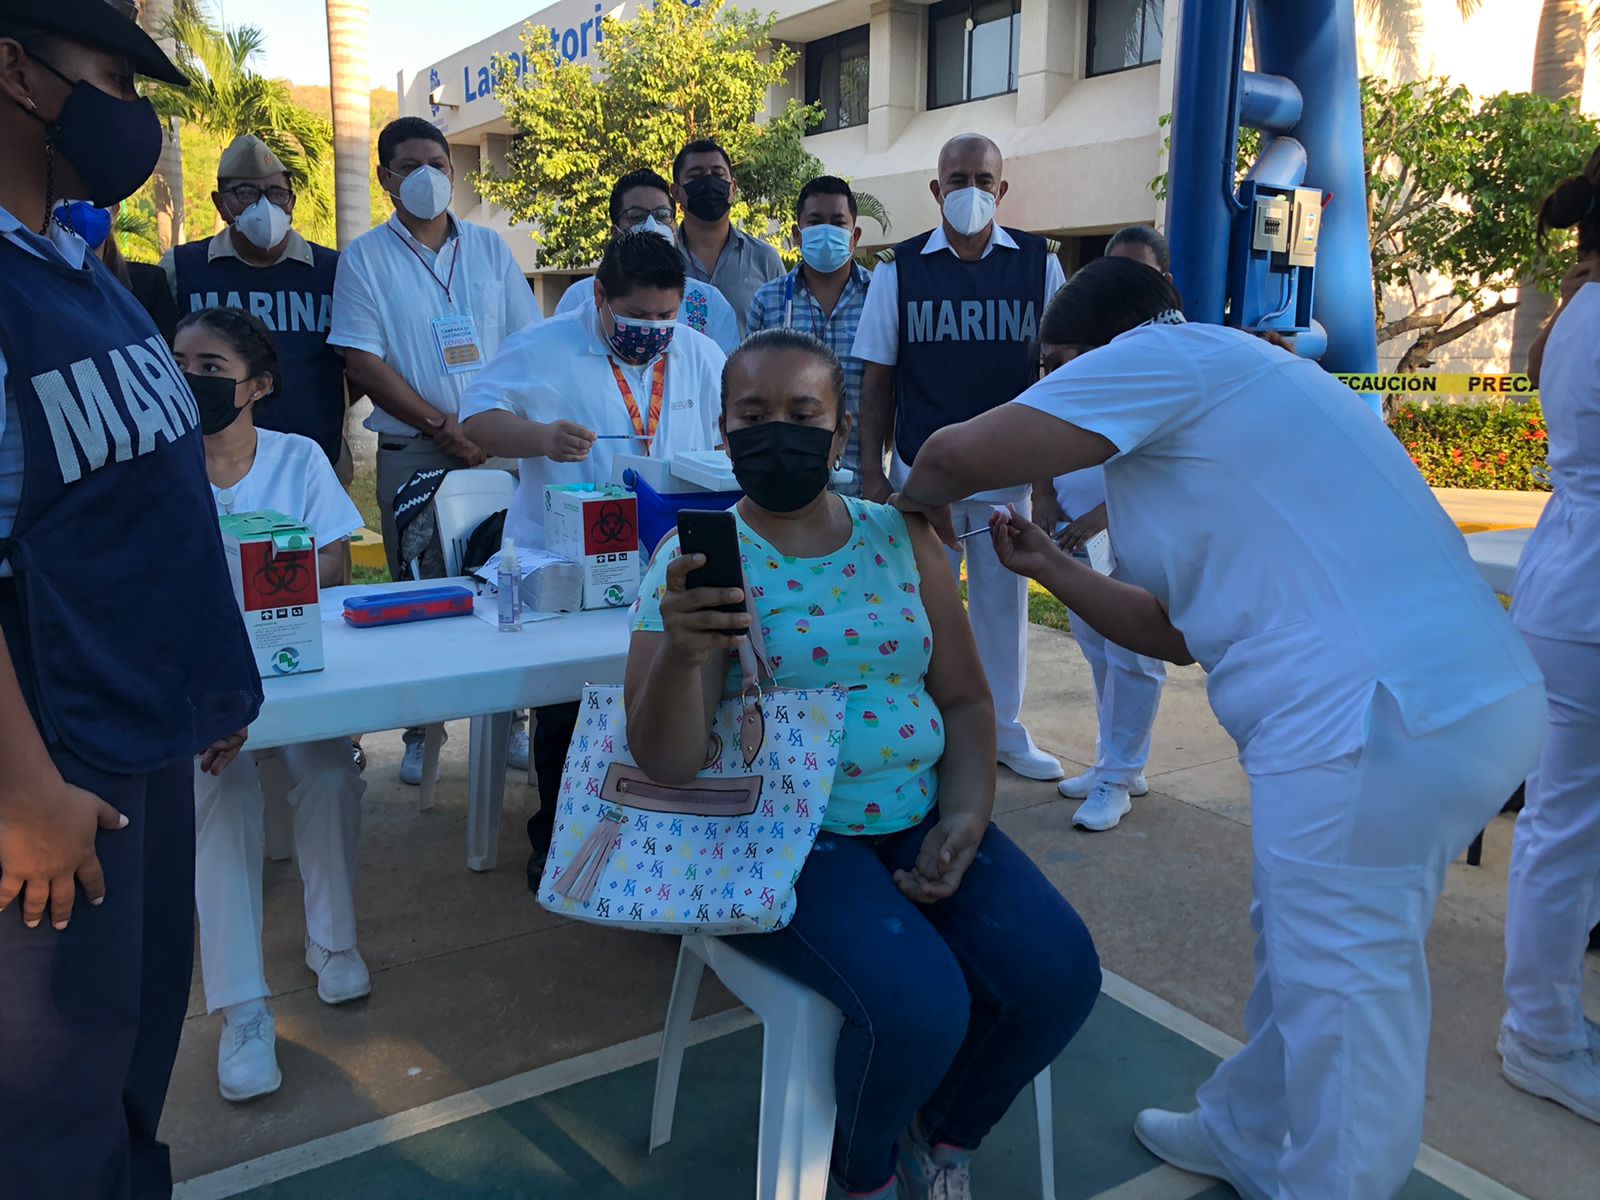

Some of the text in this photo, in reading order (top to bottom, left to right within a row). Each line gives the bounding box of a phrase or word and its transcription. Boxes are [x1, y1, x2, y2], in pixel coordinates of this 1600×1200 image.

[906, 299, 1037, 344] MARINA
[774, 705, 790, 724] KA
[782, 775, 795, 794] KA
